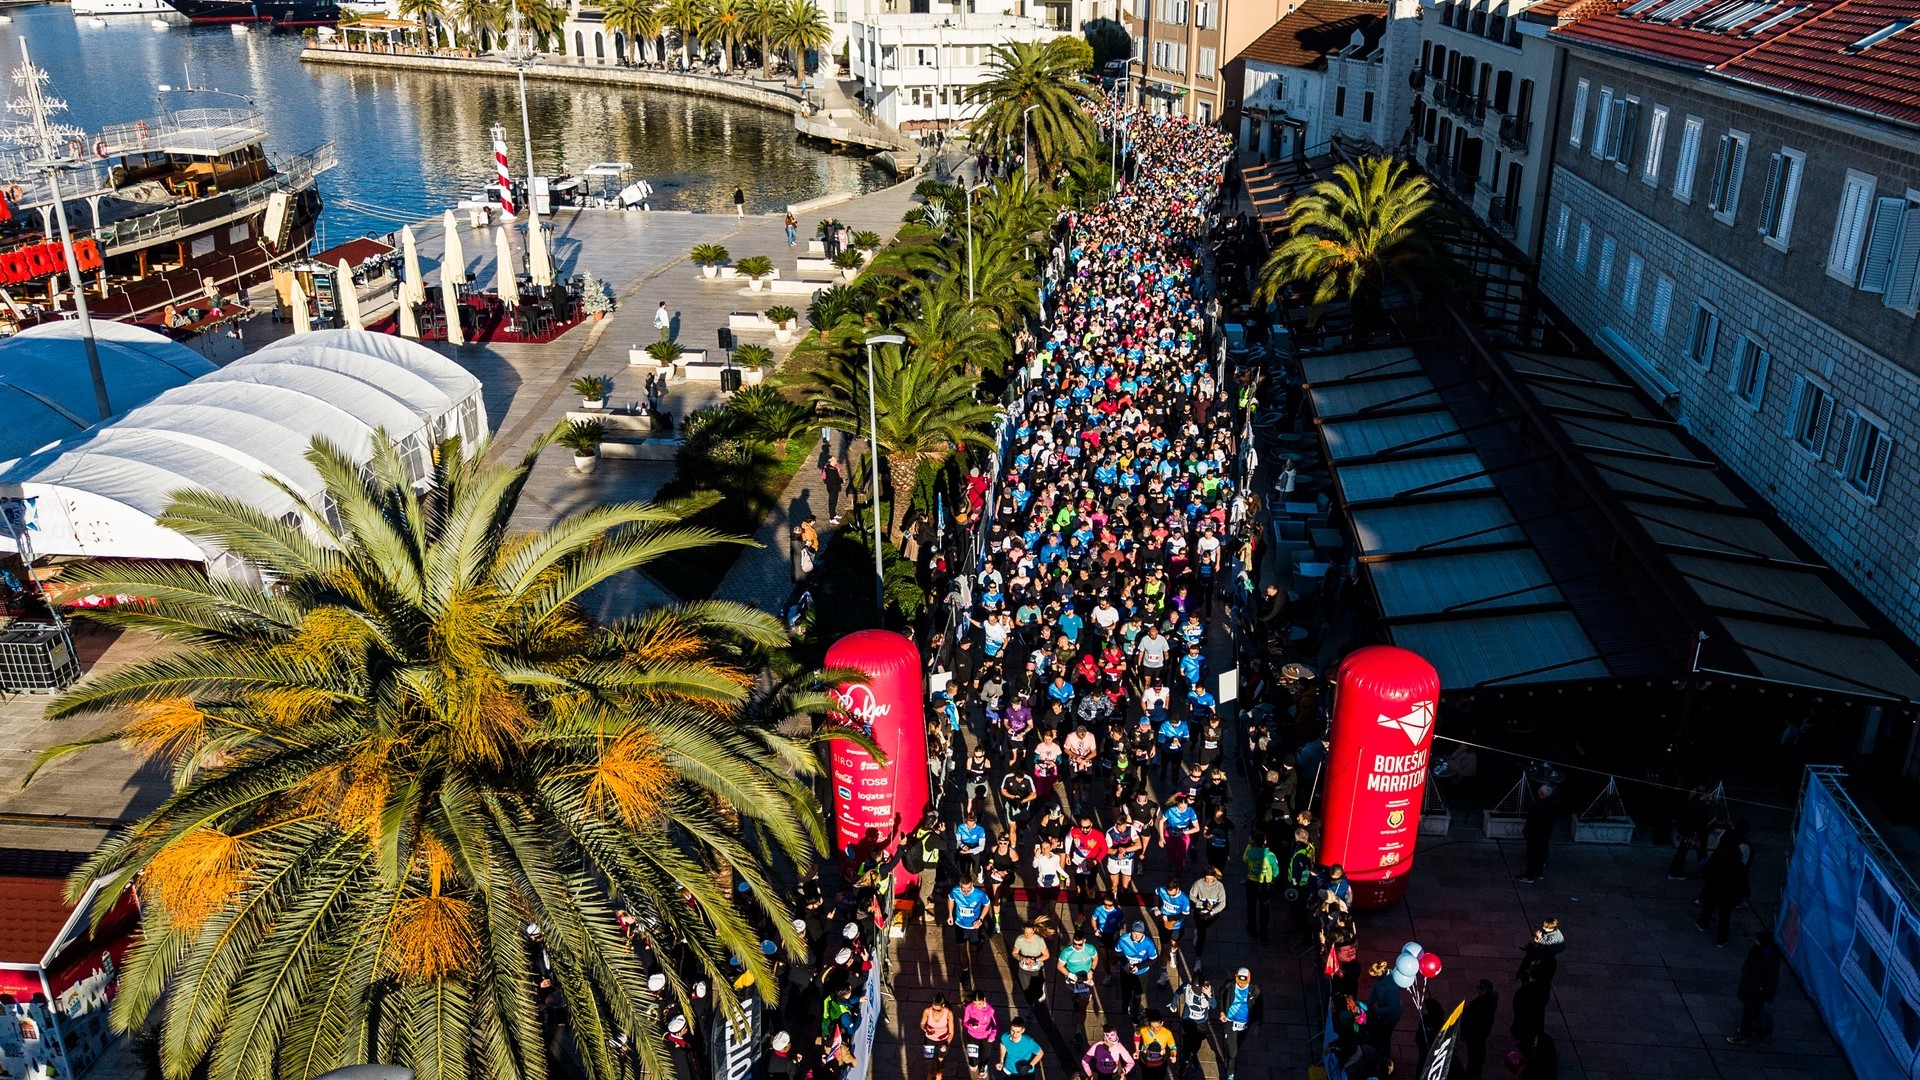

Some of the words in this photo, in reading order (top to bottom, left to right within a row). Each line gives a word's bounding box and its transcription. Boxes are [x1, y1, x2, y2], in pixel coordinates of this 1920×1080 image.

[833, 753, 853, 768] SIRO
[1374, 748, 1428, 773] BOKEŠKI
[1367, 766, 1426, 793] MARATON
[857, 791, 885, 801] logate
